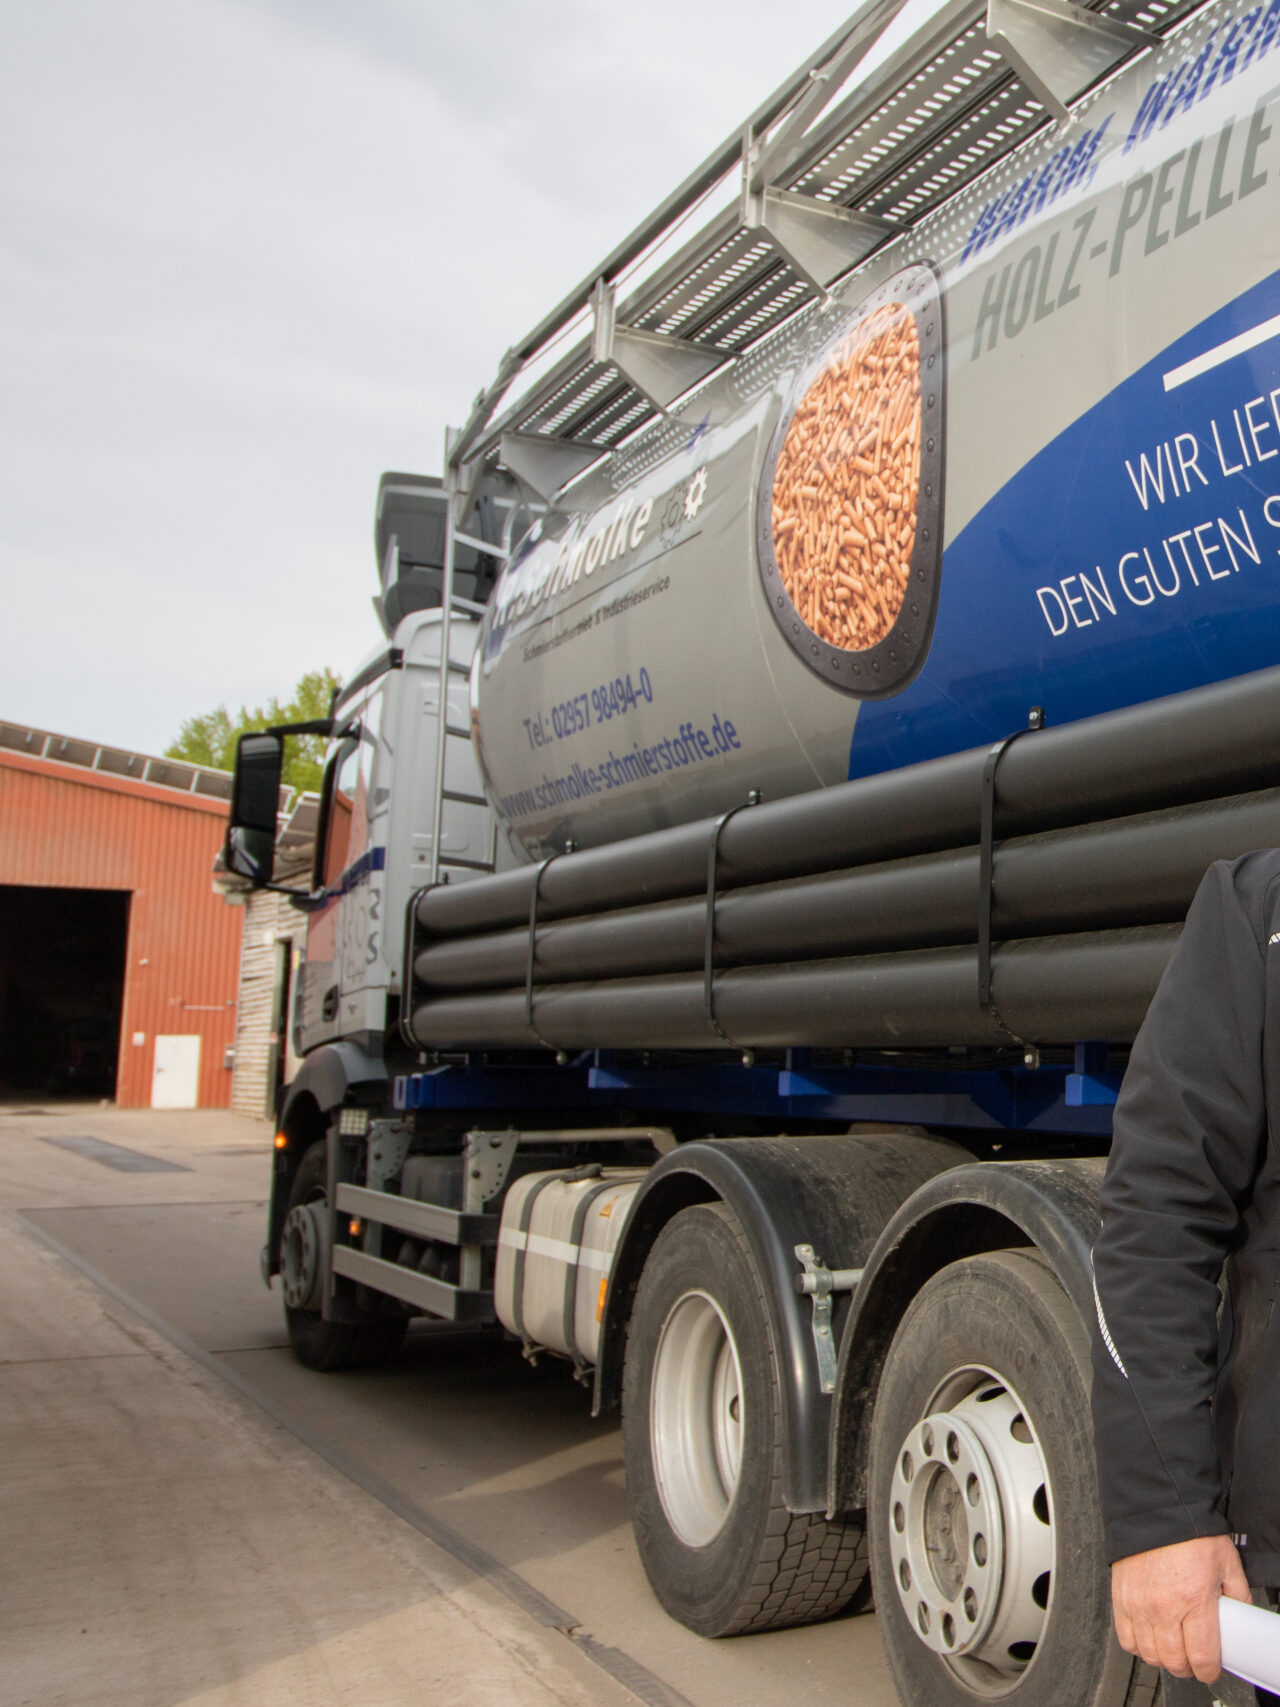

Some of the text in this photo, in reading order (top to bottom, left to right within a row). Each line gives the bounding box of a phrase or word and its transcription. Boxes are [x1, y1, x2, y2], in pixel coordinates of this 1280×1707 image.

[1125, 432, 1208, 511] WIR
[1036, 566, 1117, 636] DEN
[1118, 509, 1261, 606] GUTEN
[523, 666, 654, 752] Tel.: 02957 98494-0
[502, 713, 741, 820] www.schmolke-schmierstoffe.de
